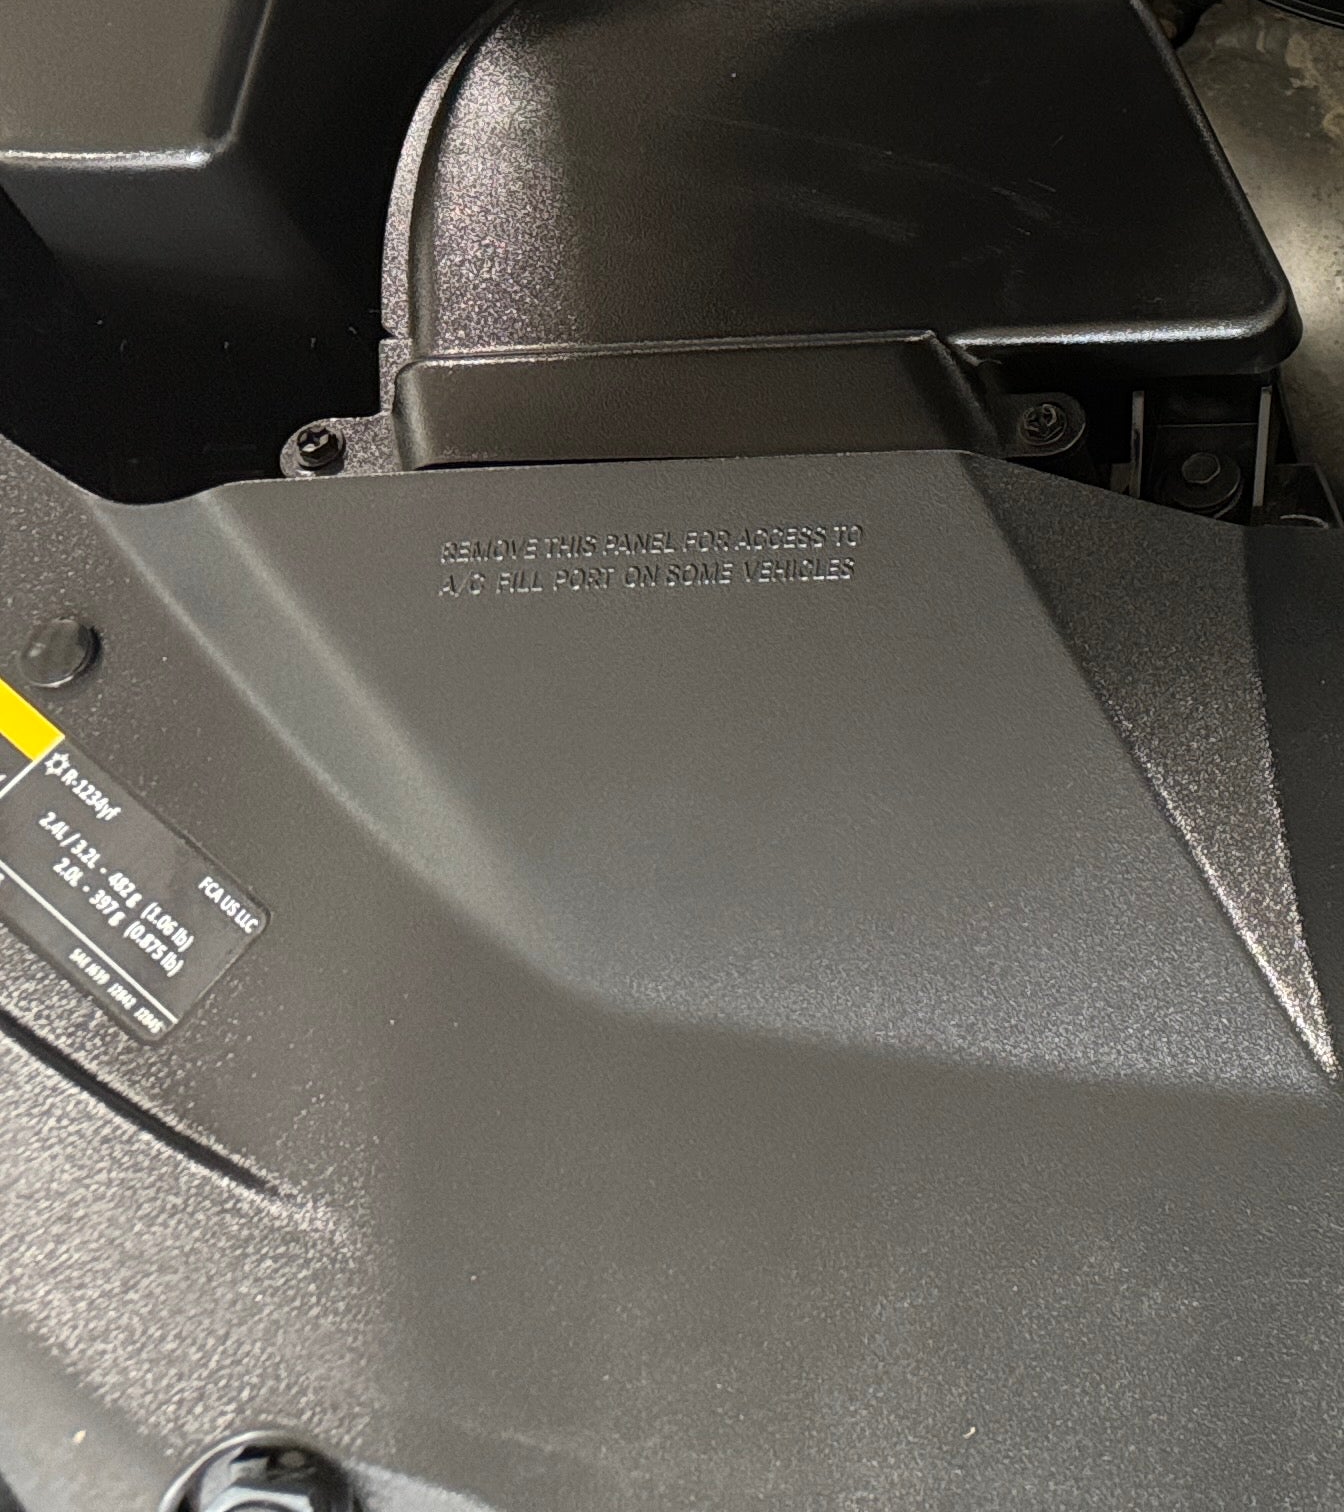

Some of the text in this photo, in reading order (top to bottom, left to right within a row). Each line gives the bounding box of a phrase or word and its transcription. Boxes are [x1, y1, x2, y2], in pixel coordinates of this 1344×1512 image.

[441, 524, 864, 564] REMOVE THIS PANEL FOR ACCESS TO
[438, 557, 856, 597] A/C FILL PORT ON SOME VEHICLES
[61, 769, 121, 820] R-1234yf
[39, 812, 69, 840] 2.4L
[71, 840, 101, 869] 3.2L
[140, 902, 178, 936] (1.06
[171, 928, 194, 952] lb)
[198, 877, 258, 933] FCA US LLC
[53, 858, 83, 887] 2.0L
[89, 889, 119, 919] 397
[123, 921, 168, 960] (0.875
[160, 952, 184, 977] lb)
